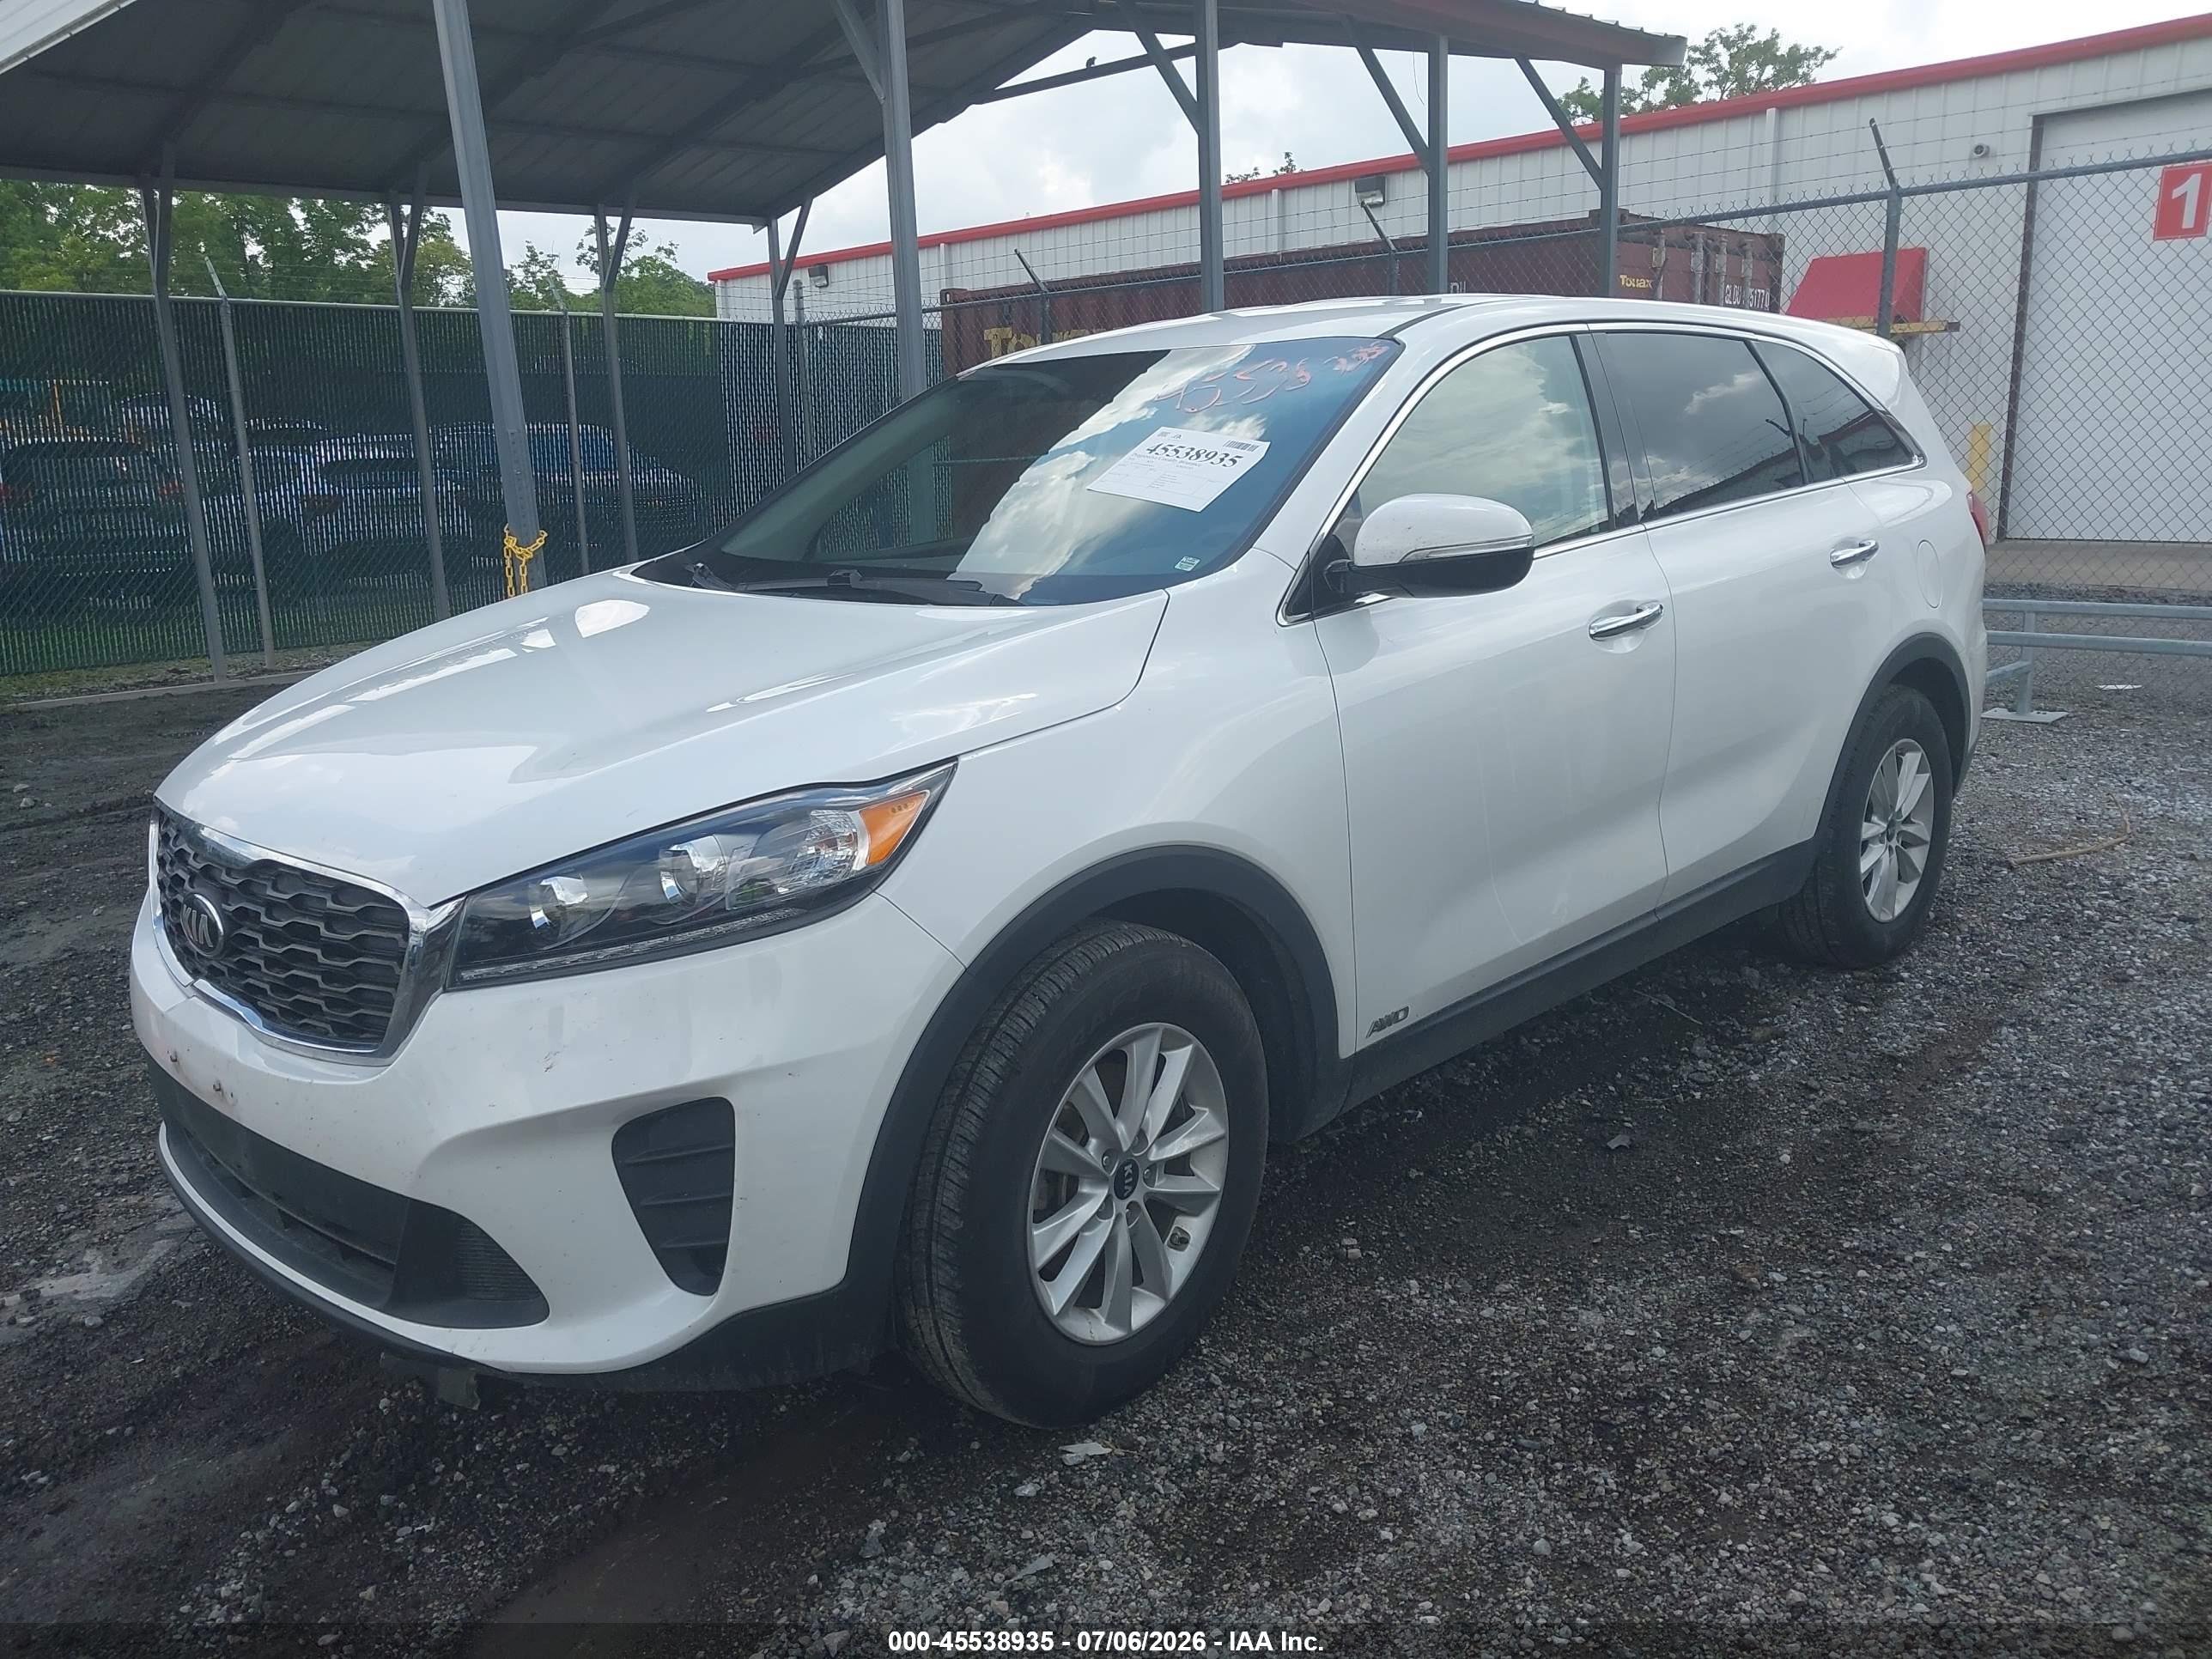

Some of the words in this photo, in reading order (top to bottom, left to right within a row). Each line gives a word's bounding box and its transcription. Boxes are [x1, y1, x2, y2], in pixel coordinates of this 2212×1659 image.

[2171, 173, 2203, 229] 1
[1146, 442, 1244, 468] 45538935
[182, 904, 214, 948] KIA
[1124, 1164, 1133, 1196] KIA
